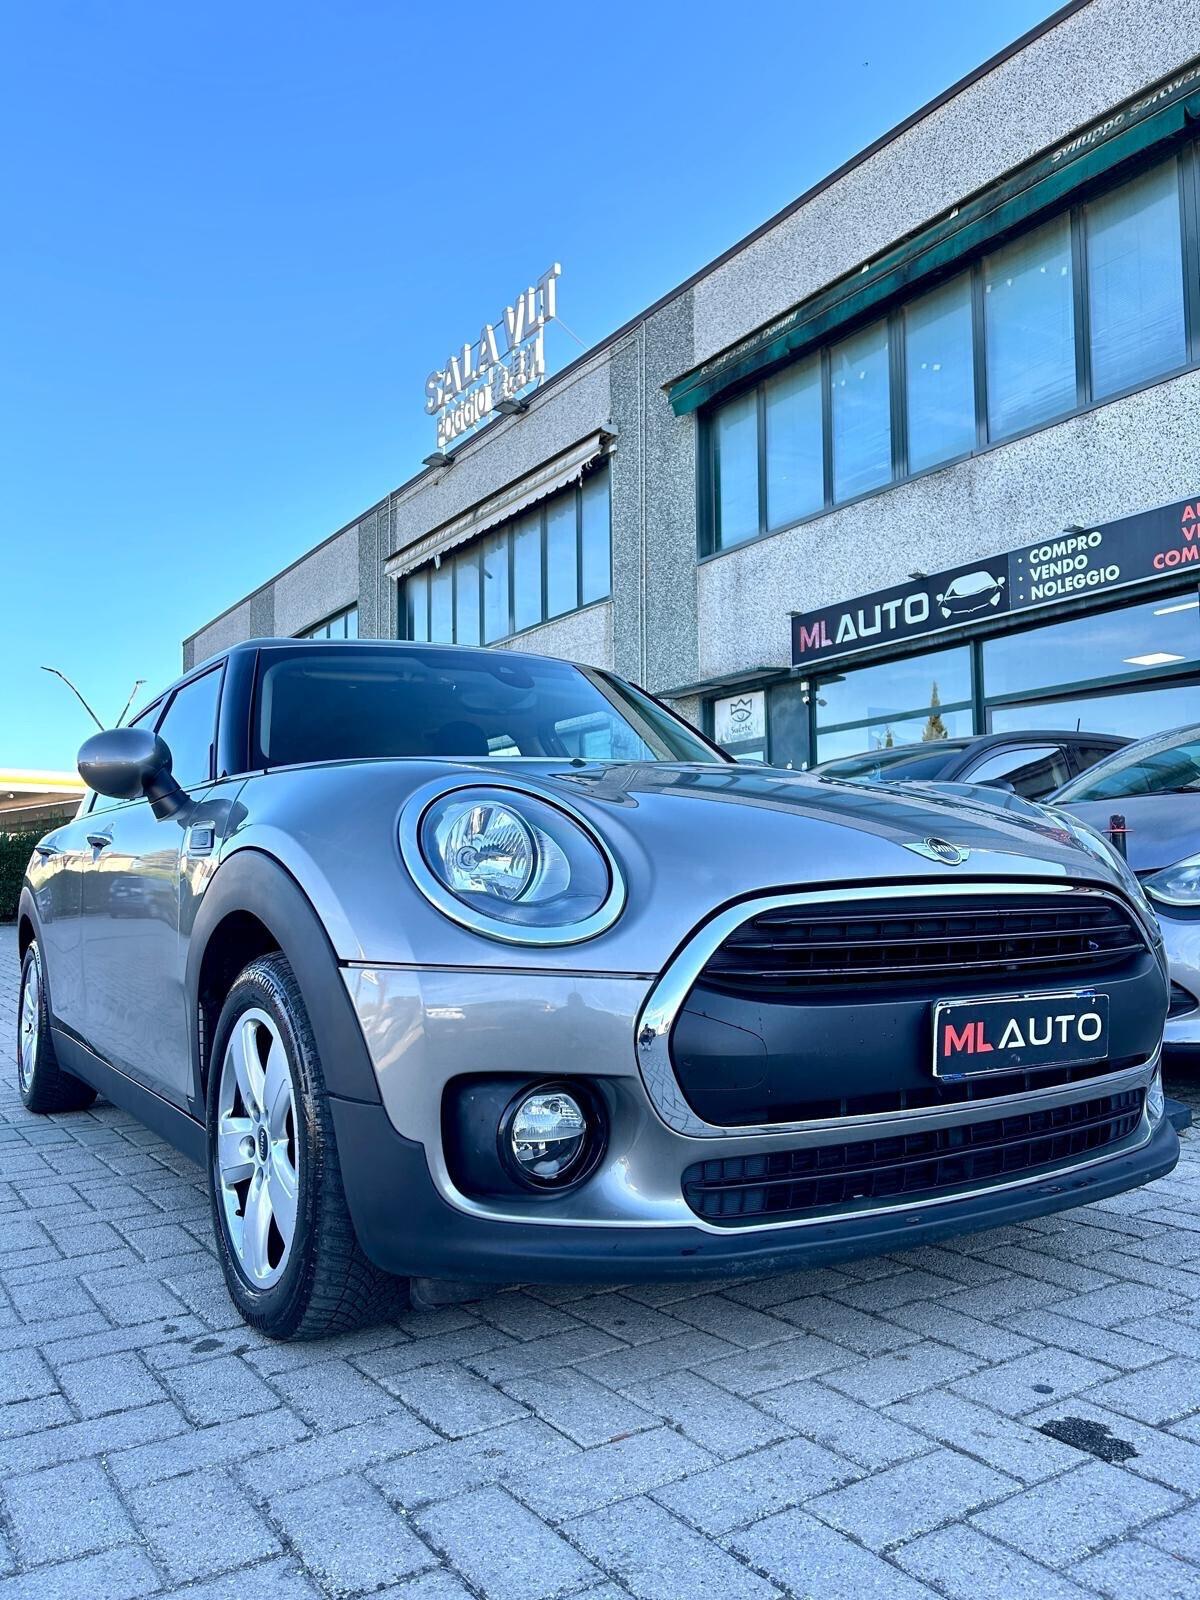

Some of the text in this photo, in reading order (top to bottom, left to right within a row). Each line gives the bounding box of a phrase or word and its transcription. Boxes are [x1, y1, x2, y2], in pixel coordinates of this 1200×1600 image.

[424, 323, 499, 415] SALA
[1029, 531, 1102, 564] COMPRO
[1029, 554, 1088, 581] VENDO
[1031, 564, 1120, 600] NOLEGGIO
